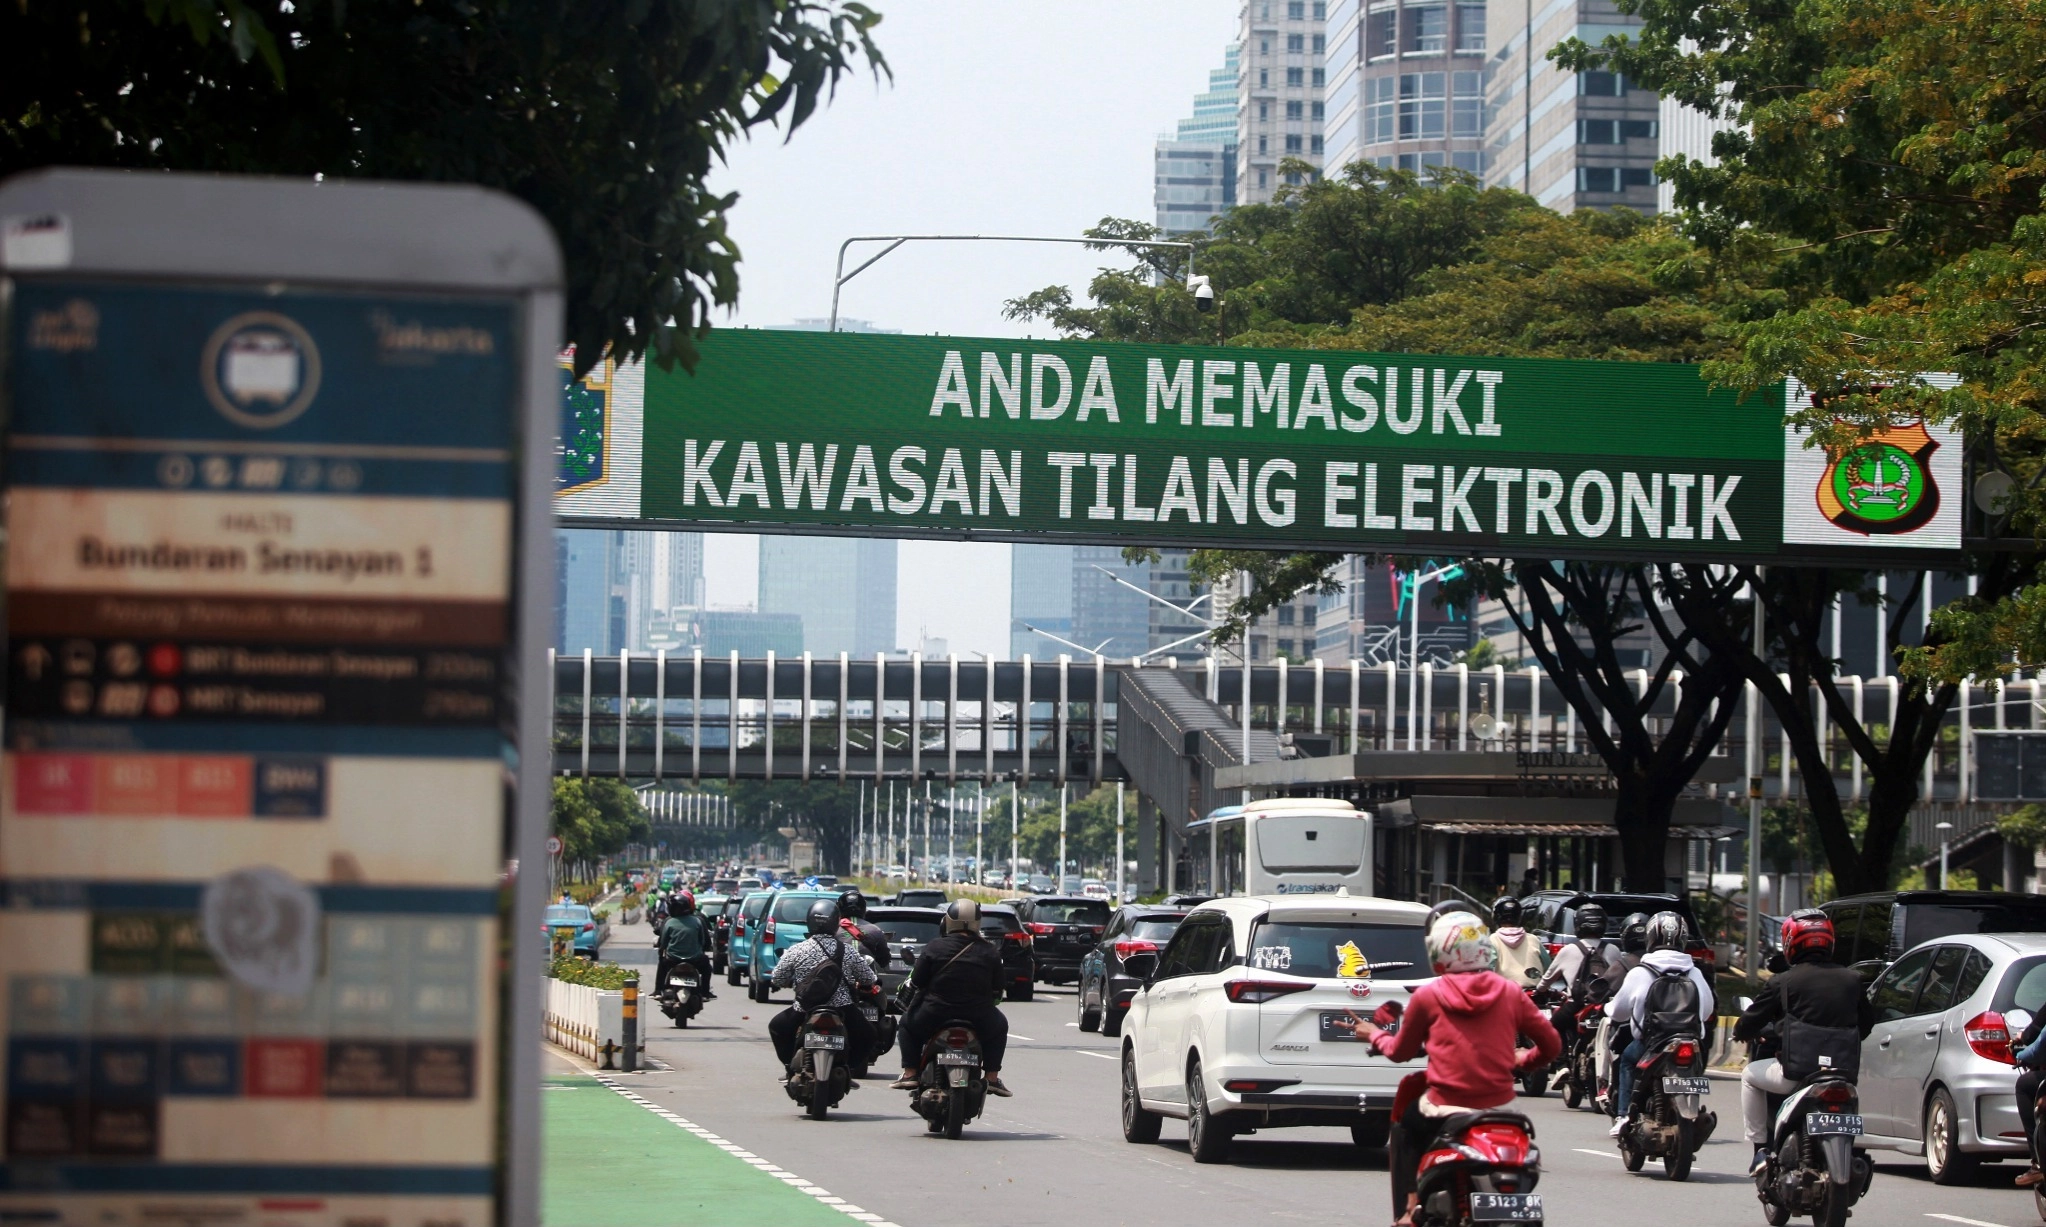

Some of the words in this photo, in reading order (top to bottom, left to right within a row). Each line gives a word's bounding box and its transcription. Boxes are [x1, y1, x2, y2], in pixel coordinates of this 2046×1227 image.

[930, 350, 1120, 423] ANDA
[1145, 358, 1503, 437] MEMASUKI
[682, 438, 1023, 517] KAWASAN
[1047, 451, 1297, 527] TILANG
[1323, 460, 1744, 542] ELEKTRONIK
[79, 537, 246, 570] Bundaran
[256, 541, 405, 581] Senayan
[415, 547, 433, 577] 1
[1323, 1016, 1330, 1029] E
[1808, 1115, 1813, 1124] B
[1818, 1115, 1841, 1124] 4743
[1845, 1116, 1861, 1125] FIS
[1473, 1195, 1481, 1207] F
[1488, 1195, 1518, 1207] 5123
